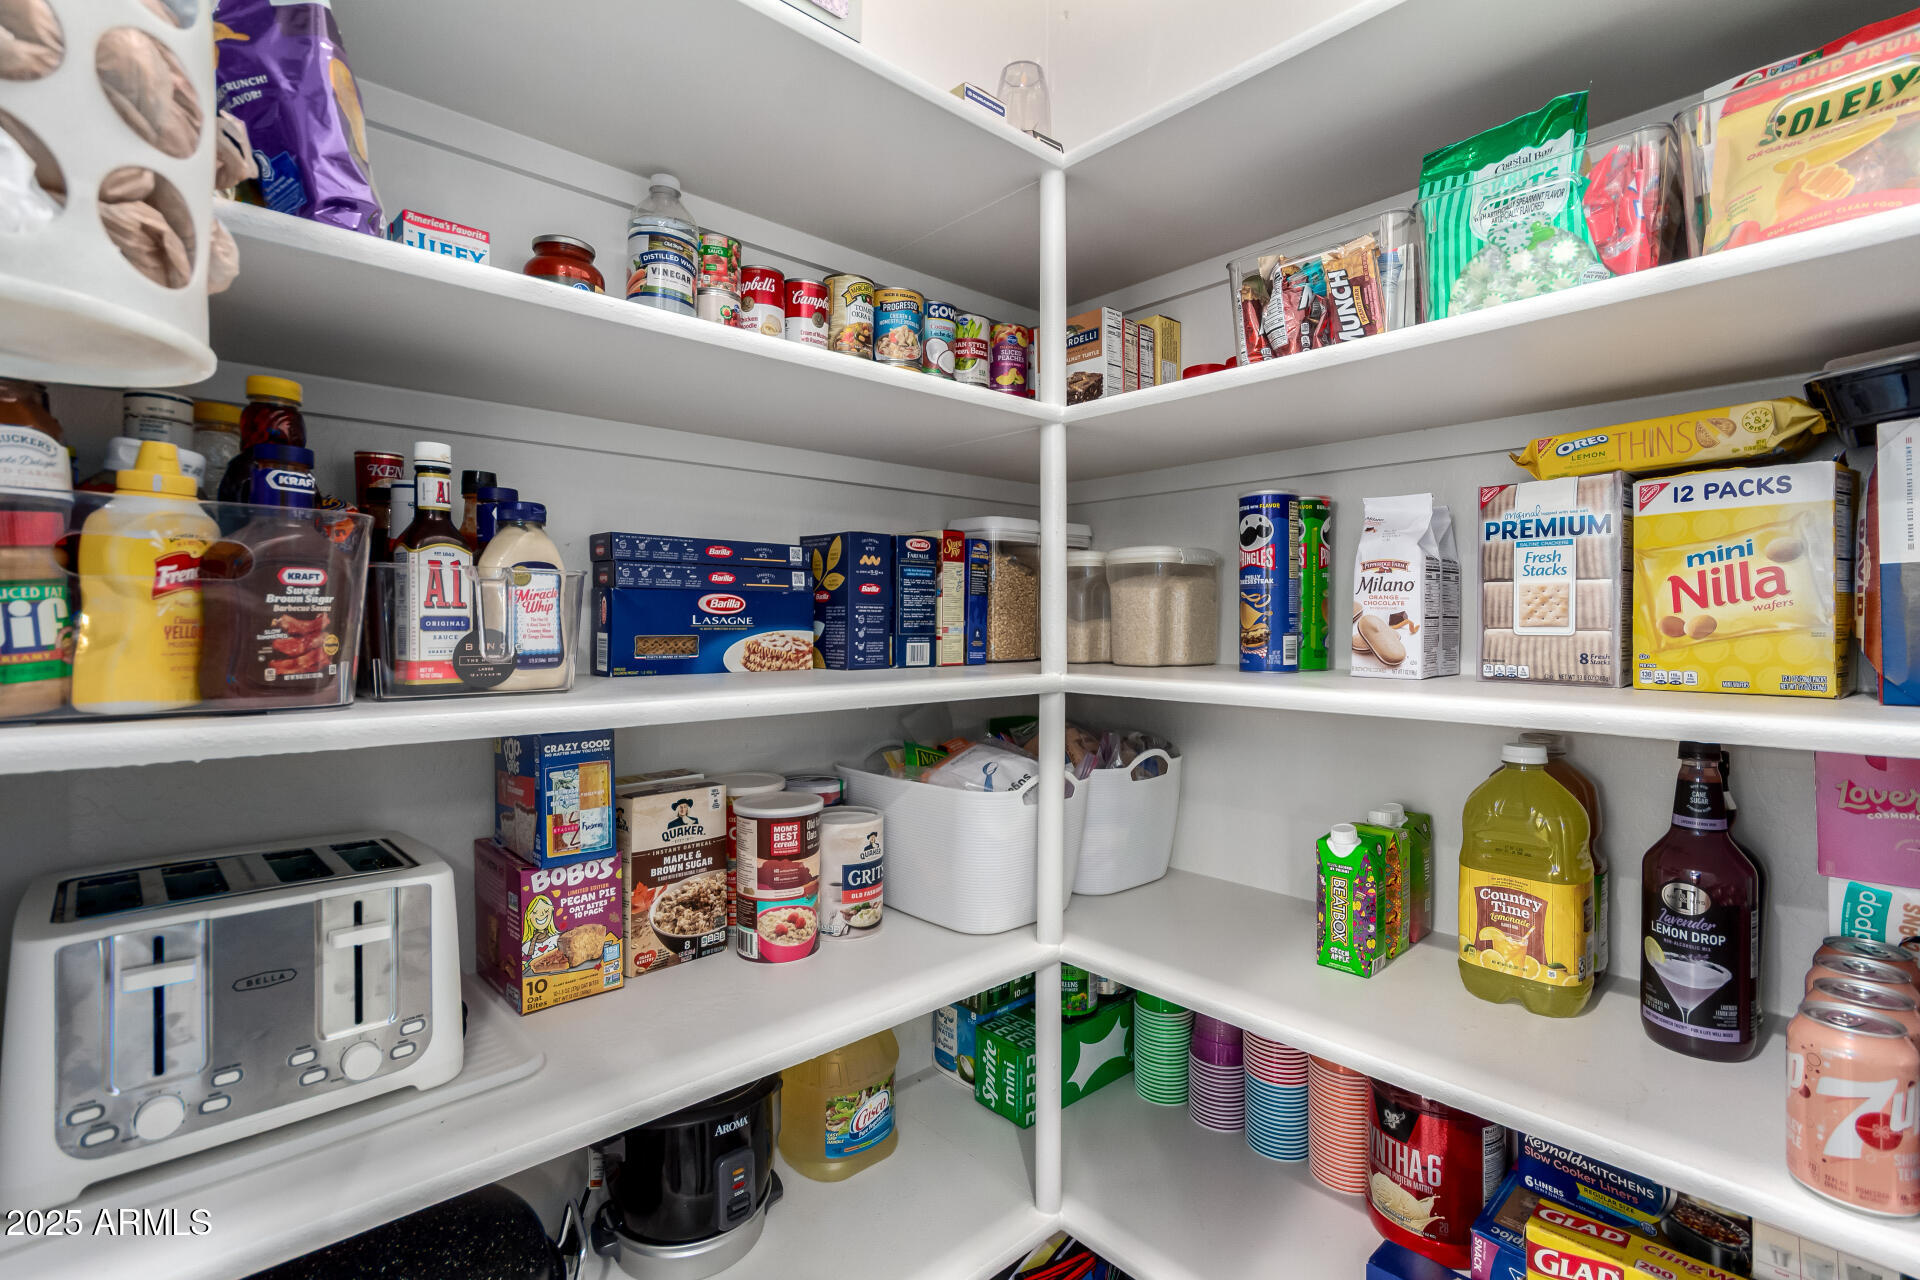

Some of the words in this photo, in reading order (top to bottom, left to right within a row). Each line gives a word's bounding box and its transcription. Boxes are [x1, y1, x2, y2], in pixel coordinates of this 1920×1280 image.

[1758, 64, 1920, 147] SOLELY
[406, 211, 450, 231] America's
[643, 253, 680, 262] DISTILLED
[651, 266, 691, 284] VINEGAR
[882, 301, 918, 312] PROGRESSO
[1556, 435, 1609, 456] OREO
[1612, 421, 1693, 462] THINS
[1571, 450, 1606, 461] LEMON
[1673, 486, 1694, 503] 12
[1704, 475, 1792, 500] PACKS
[1485, 514, 1612, 540] PREMIUM
[708, 548, 731, 556] Barilla
[1525, 550, 1561, 563] Fresh
[1686, 539, 1754, 568] mini
[287, 572, 320, 580] KRAFT
[711, 574, 733, 582] Barilla
[1522, 563, 1567, 576] Stacks
[45, 586, 63, 598] FAT
[286, 585, 320, 595] Sweet
[861, 585, 880, 593] Barilla
[1356, 576, 1415, 595] Milano
[1667, 561, 1790, 613] Nilla
[266, 593, 304, 603] Brown
[304, 594, 335, 605] Sugar
[522, 600, 553, 615] Whip
[710, 598, 740, 609] Barilla
[1753, 599, 1794, 612] wafers
[692, 615, 753, 625] LASAGNE
[1579, 652, 1589, 665] 8
[544, 742, 579, 753] CRAZY
[581, 740, 610, 749] GOOD
[662, 826, 704, 842] QUAKER
[773, 824, 798, 833] MOM'S
[773, 831, 798, 842] BEST
[652, 847, 681, 856] INSTANT
[683, 841, 712, 850] OATMEAL
[773, 840, 798, 848] cereals
[663, 852, 694, 865] MAPLE
[695, 850, 702, 858] &
[531, 858, 615, 893] BOBO'S
[650, 863, 684, 877] BROWN
[685, 857, 713, 870] SUGAR
[560, 892, 596, 907] PECAN
[598, 887, 617, 899] PIE
[851, 891, 863, 899] OLD
[1480, 888, 1542, 913] Country
[569, 904, 585, 914] OAT
[586, 899, 608, 909] BITES
[583, 907, 604, 917] PACK
[1332, 878, 1347, 942] BEATBOX
[1490, 900, 1530, 919] Time
[1490, 911, 1530, 928] Lemonade
[1656, 906, 1717, 931] Lavender
[1651, 919, 1689, 940] LEMON
[1691, 932, 1726, 946] DROP
[684, 940, 690, 949] 8
[246, 972, 286, 987] BELLA
[526, 978, 548, 996] 10
[527, 996, 542, 1004] Oat
[527, 1001, 548, 1011] Bites
[982, 1039, 1000, 1108] Sprite
[1004, 1060, 1016, 1107] mini
[855, 1098, 887, 1131] Crisco
[714, 1116, 748, 1137] AROMA
[1524, 1145, 1551, 1165] Slow
[1553, 1159, 1597, 1185] Cooker
[1599, 1179, 1639, 1204] Liners
[1588, 1164, 1655, 1200] KITCHENS
[1524, 1175, 1534, 1188] 6
[1534, 1179, 1565, 1198] LINERS
[1583, 1187, 1617, 1206] REGULAR
[1618, 1204, 1635, 1214] SIZE
[1539, 1209, 1627, 1244] GLAD
[1474, 1237, 1482, 1272] SNACK
[1642, 1243, 1703, 1276] Cling
[1533, 1248, 1620, 1280] GLAD
[1637, 1259, 1675, 1280] 200
